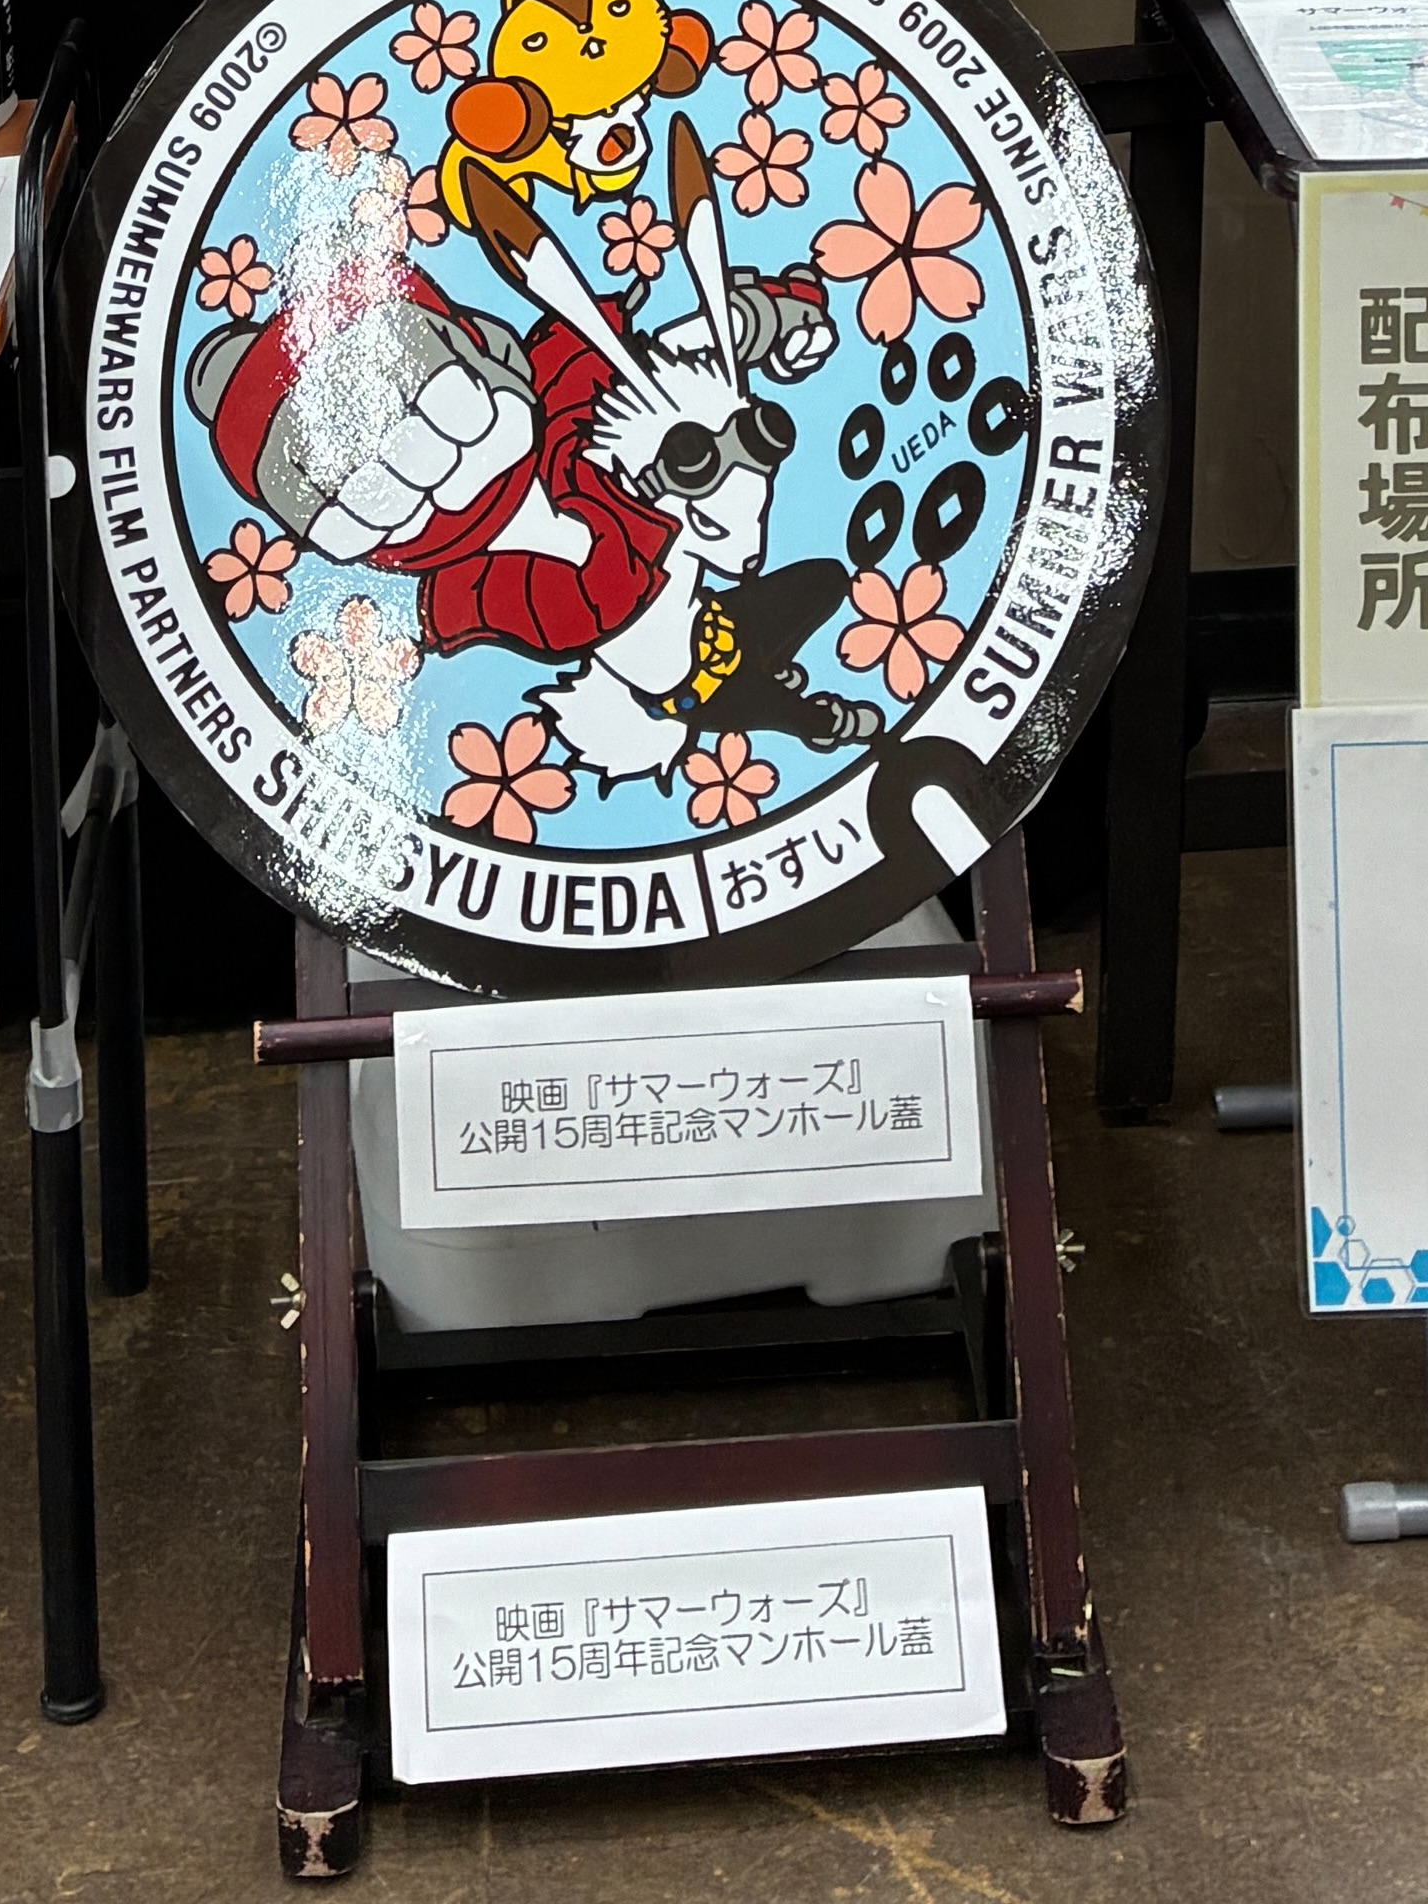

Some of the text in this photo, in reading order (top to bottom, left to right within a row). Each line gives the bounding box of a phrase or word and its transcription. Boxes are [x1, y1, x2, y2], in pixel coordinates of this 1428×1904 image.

[974, 86, 1059, 208] SINCE
[97, 136, 203, 432] SUMMERWARS
[891, 409, 958, 475] UEDA
[98, 446, 148, 549] FILM
[963, 433, 1106, 722] SUMMER
[120, 564, 254, 764] PARTNERS
[520, 871, 686, 937] UEDA
[720, 817, 863, 912] おすい
[459, 1094, 924, 1156] 公開15周年記念マンホール蓋
[500, 1056, 864, 1116] 映画『サマーウォーズ』
[495, 1575, 870, 1644] 映画『サマーウォーズ』
[452, 1616, 935, 1689] 公開15周年記念マンホール蓋
